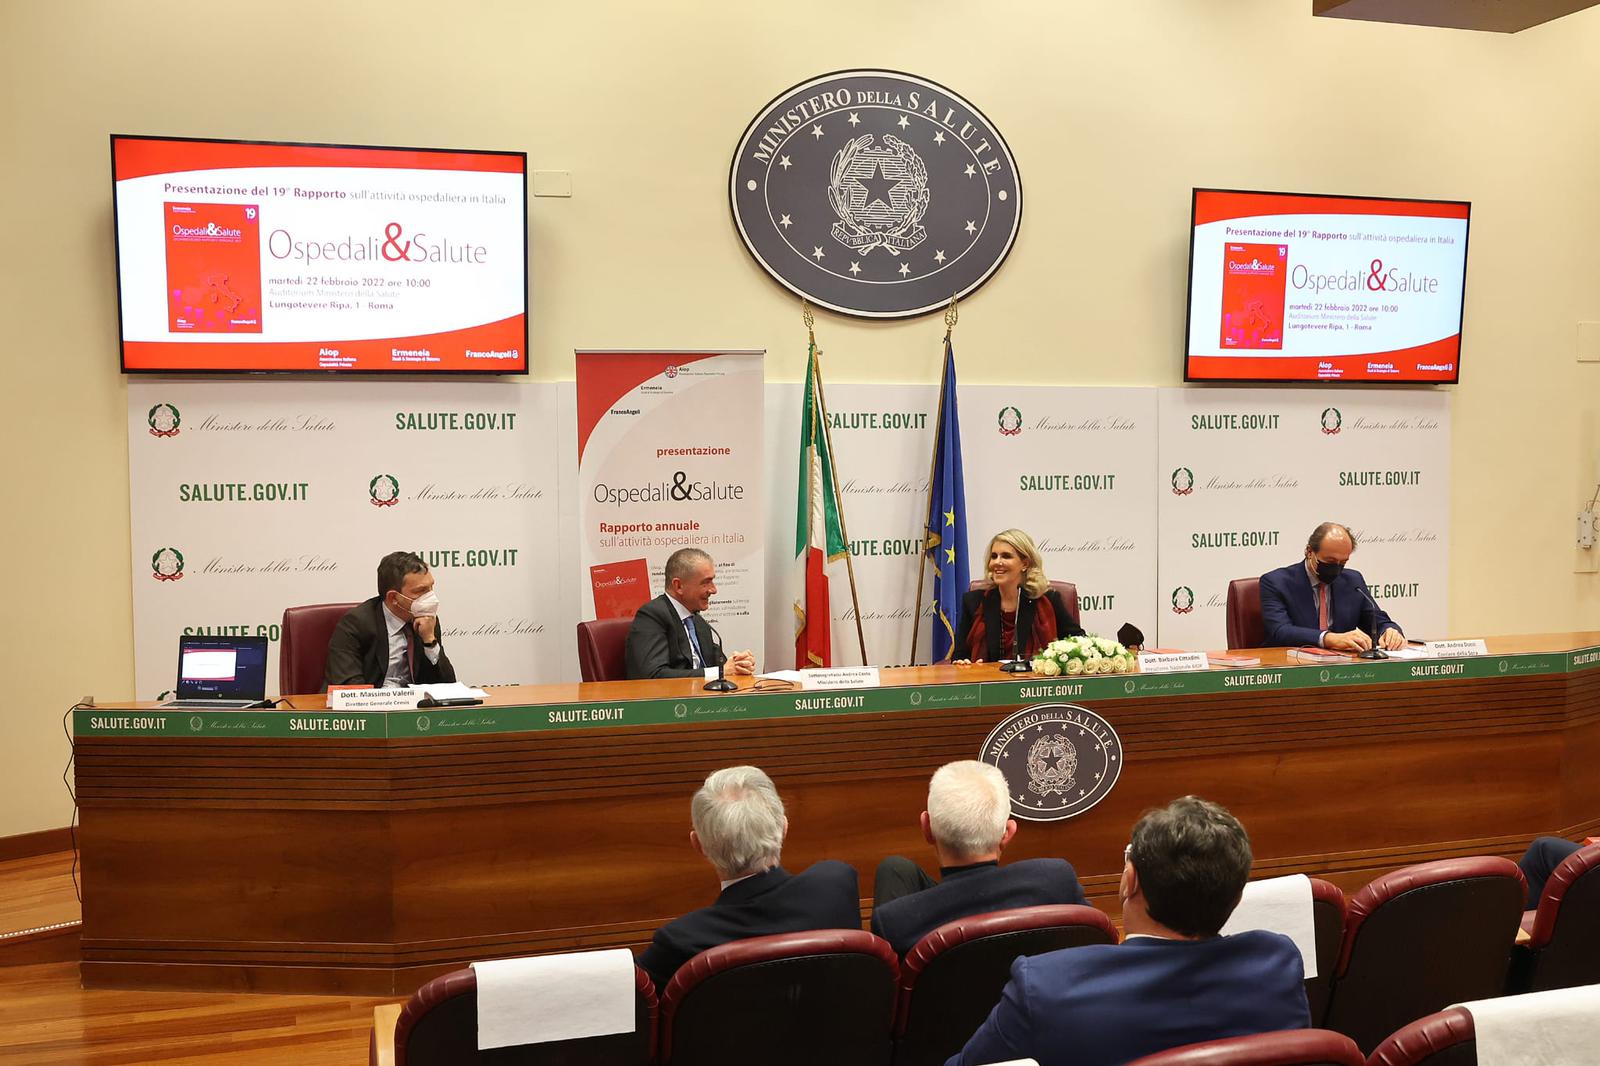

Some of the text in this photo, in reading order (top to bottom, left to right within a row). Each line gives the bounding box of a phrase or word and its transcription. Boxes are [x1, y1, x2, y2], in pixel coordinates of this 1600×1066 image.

[752, 88, 1001, 176] MINISTERO DELLA SALUTE
[164, 182, 248, 196] Presentazione
[251, 186, 269, 196] del
[294, 187, 346, 200] Rapporto
[409, 192, 467, 204] ospedaliera
[470, 193, 479, 203] in
[482, 194, 506, 205] Italia
[245, 207, 256, 219] 19
[887, 231, 925, 247] ITALIANA
[1226, 226, 1282, 238] Presentazione
[1284, 229, 1296, 238] del
[1312, 230, 1348, 241] Rapporto
[268, 222, 487, 266] Ospedali&Salute
[306, 277, 318, 286] 22
[321, 276, 359, 286] febbraio
[362, 278, 384, 287] 2022
[406, 279, 431, 288] 10:00
[1291, 259, 1439, 295] Ospedali&Salute
[269, 300, 328, 311] Lungotevere
[368, 302, 394, 310] Roma
[1325, 303, 1350, 311] febbraio
[1352, 304, 1368, 312] 2022
[1288, 322, 1328, 331] Lungotevere
[1354, 323, 1372, 331] Roma
[396, 412, 517, 431] SALUTE.GOV.IT
[1191, 414, 1280, 430] SALUTE.GOV.IT
[656, 446, 731, 458] presentazione
[1020, 475, 1115, 491] SALUTE.GOV.IT
[1339, 470, 1421, 486] SALUTE.GOV.IT
[179, 482, 309, 502] SALUTE.GOV.IT
[594, 471, 744, 507] Ospedali&Salute
[600, 520, 700, 535] Rapporto annuale
[654, 534, 709, 547] ospedaliera
[711, 534, 721, 544] in
[722, 533, 745, 544] Italia
[1192, 531, 1280, 548] SALUTE.GOV.IT
[1367, 583, 1419, 599] TE.GOV.IT
[836, 606, 884, 620] Miistero
[1411, 664, 1465, 677] SALUTE.GOV.IT
[1224, 673, 1282, 687] SALUTE.GOV.IT
[360, 690, 391, 698] Massimo
[1020, 684, 1084, 698] SALUTE.GOV.IT
[795, 696, 865, 711] SALUTE.GOV.IT
[548, 708, 625, 723] SALUTE.GOV.IT
[90, 717, 167, 730] SALUTE.GOV.IT
[289, 718, 367, 732] SALUTE.GOV.IT
[989, 710, 1114, 759] MINISTERO DELLA SALUTE
